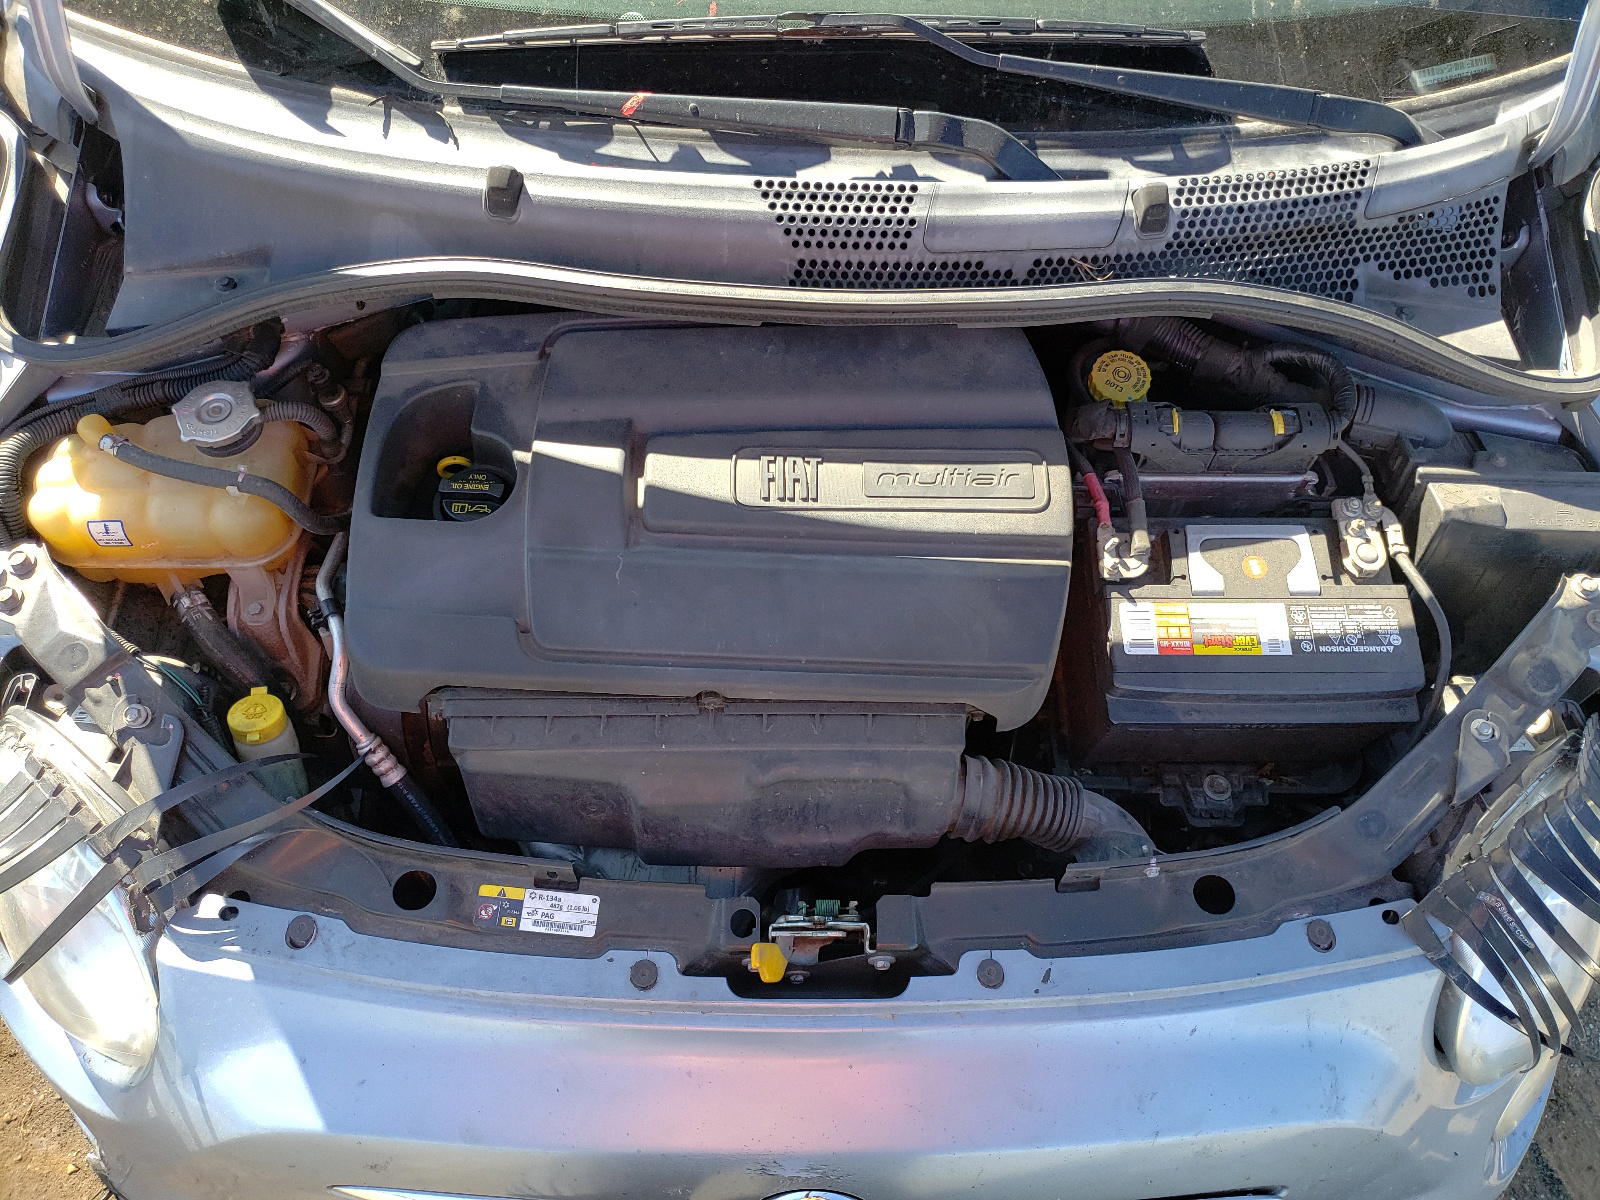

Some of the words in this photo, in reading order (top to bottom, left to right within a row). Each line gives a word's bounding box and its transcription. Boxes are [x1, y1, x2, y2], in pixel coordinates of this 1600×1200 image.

[467, 473, 487, 481] ONLY
[759, 455, 824, 503] FIAT
[875, 467, 1021, 488] multiair
[450, 482, 463, 490] OIL
[463, 483, 490, 491] ENGINE
[538, 894, 562, 903] R-134a
[540, 912, 555, 920] PAG
